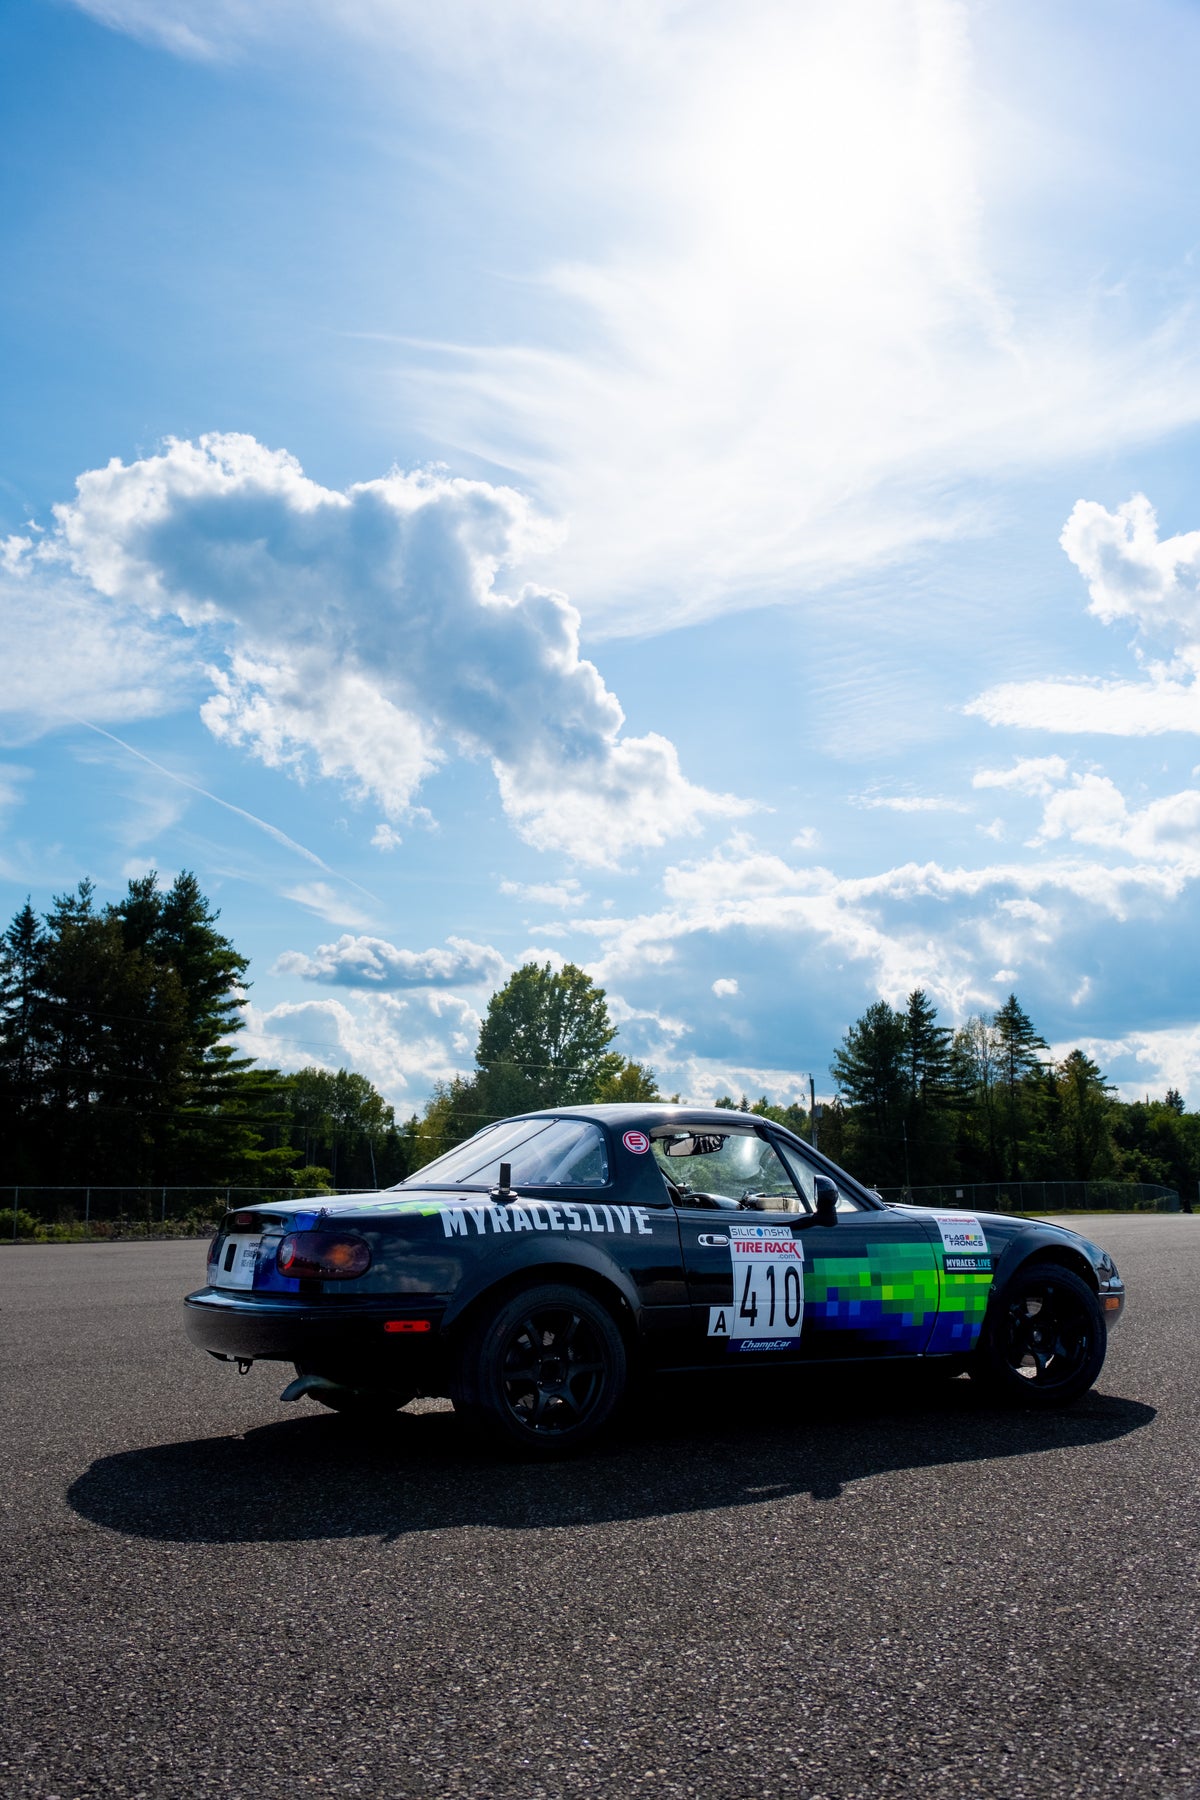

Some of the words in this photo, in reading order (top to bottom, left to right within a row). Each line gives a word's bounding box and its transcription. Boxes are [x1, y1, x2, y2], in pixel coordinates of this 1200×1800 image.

[438, 1203, 653, 1237] MYRACES.LIVE
[734, 1241, 763, 1253] TIRE
[764, 1241, 801, 1259] RACK
[946, 1258, 992, 1267] MYRACES.LIVE
[739, 1264, 801, 1328] 410
[713, 1310, 727, 1333] A
[740, 1340, 792, 1351] ChampCar
